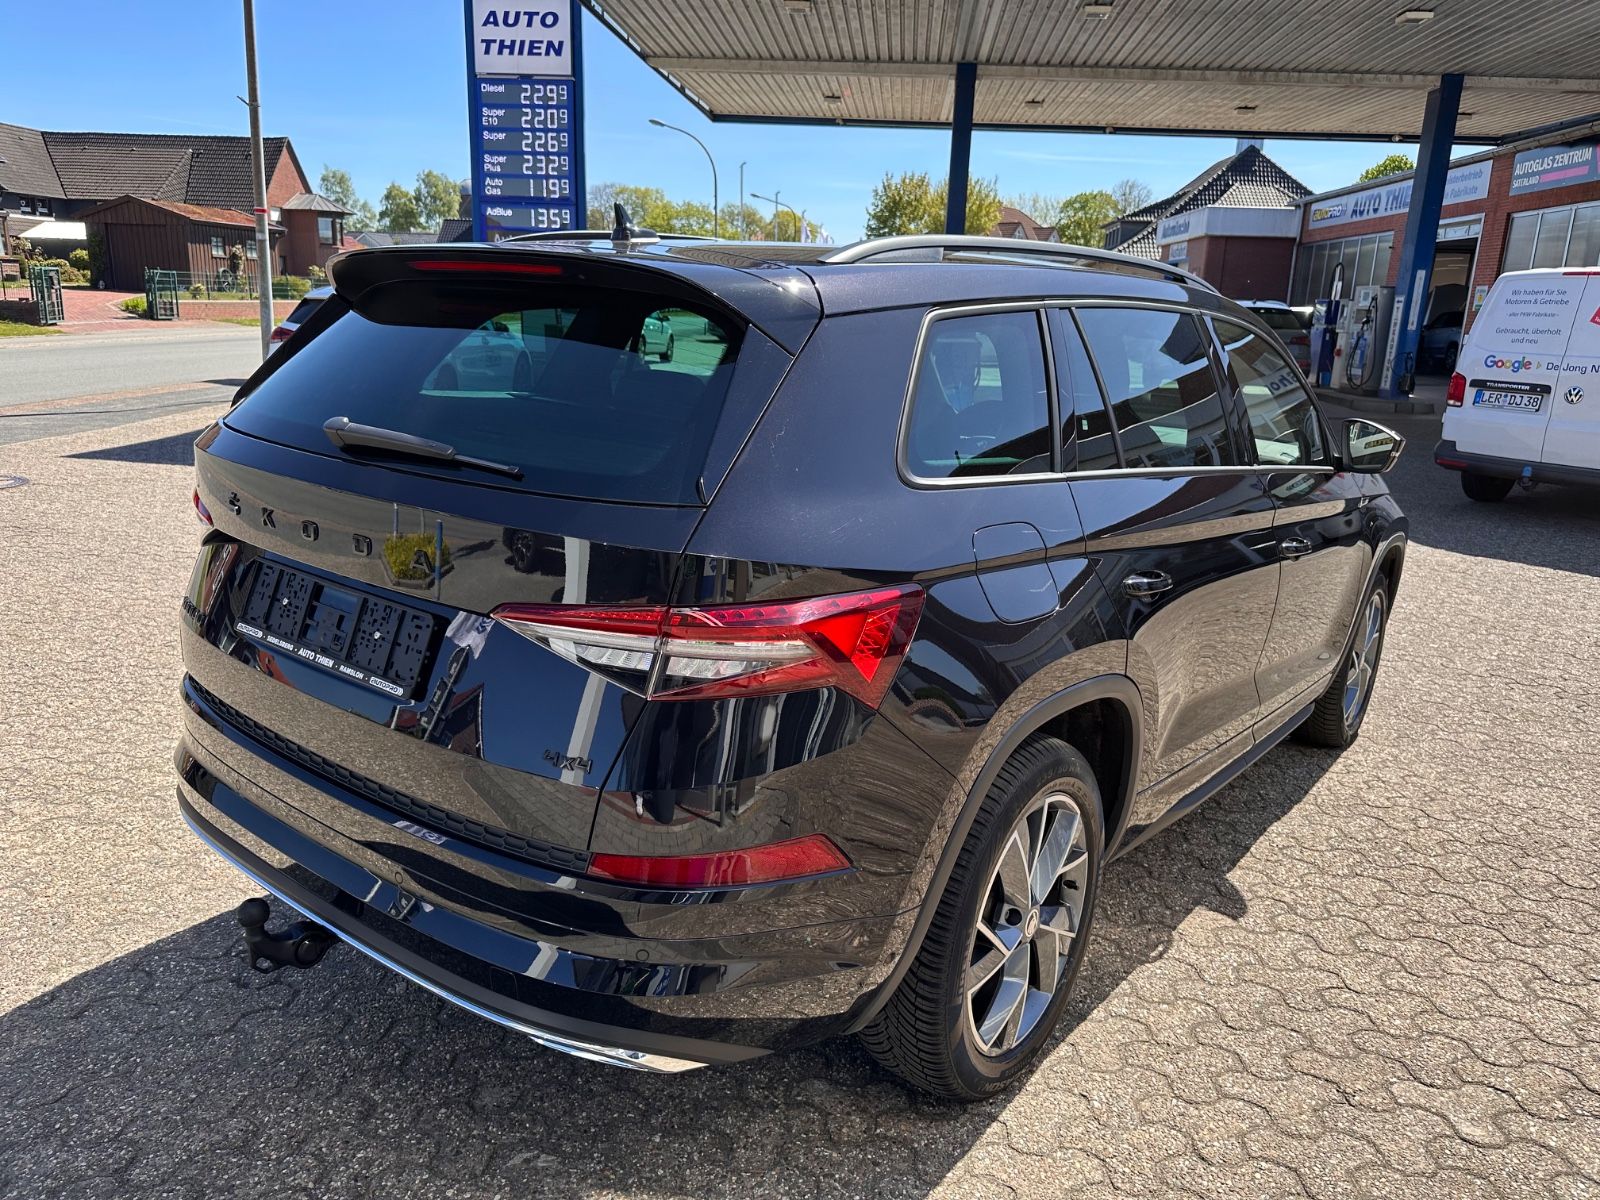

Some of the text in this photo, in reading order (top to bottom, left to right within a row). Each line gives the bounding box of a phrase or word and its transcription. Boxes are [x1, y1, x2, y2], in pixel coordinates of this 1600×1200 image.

[481, 10, 560, 29] AUTO
[480, 38, 565, 57] THIEN
[480, 83, 505, 93] Diesel
[482, 108, 506, 118] Super
[482, 116, 498, 126] E10
[482, 131, 507, 141] Super
[483, 155, 507, 164] Super
[1514, 147, 1593, 176] AUTOGLAS ZENTRUM
[484, 163, 501, 172] Plus
[485, 177, 503, 186] Auto
[1512, 175, 1540, 188] SATERLAND
[485, 186, 502, 196] Gas
[1350, 191, 1382, 219] AUTO
[1384, 183, 1412, 213] THIE
[486, 207, 513, 217] AdBlue
[1539, 298, 1570, 306] Getriebe
[1531, 327, 1562, 336] überholt
[1484, 354, 1533, 374] Google
[1546, 362, 1560, 371] De
[1562, 363, 1588, 375] Jong
[1486, 382, 1530, 391] TRANSPORTER
[1480, 392, 1540, 408] LER DJ 38
[297, 647, 316, 661] AUTO
[315, 653, 335, 669] THIEN
